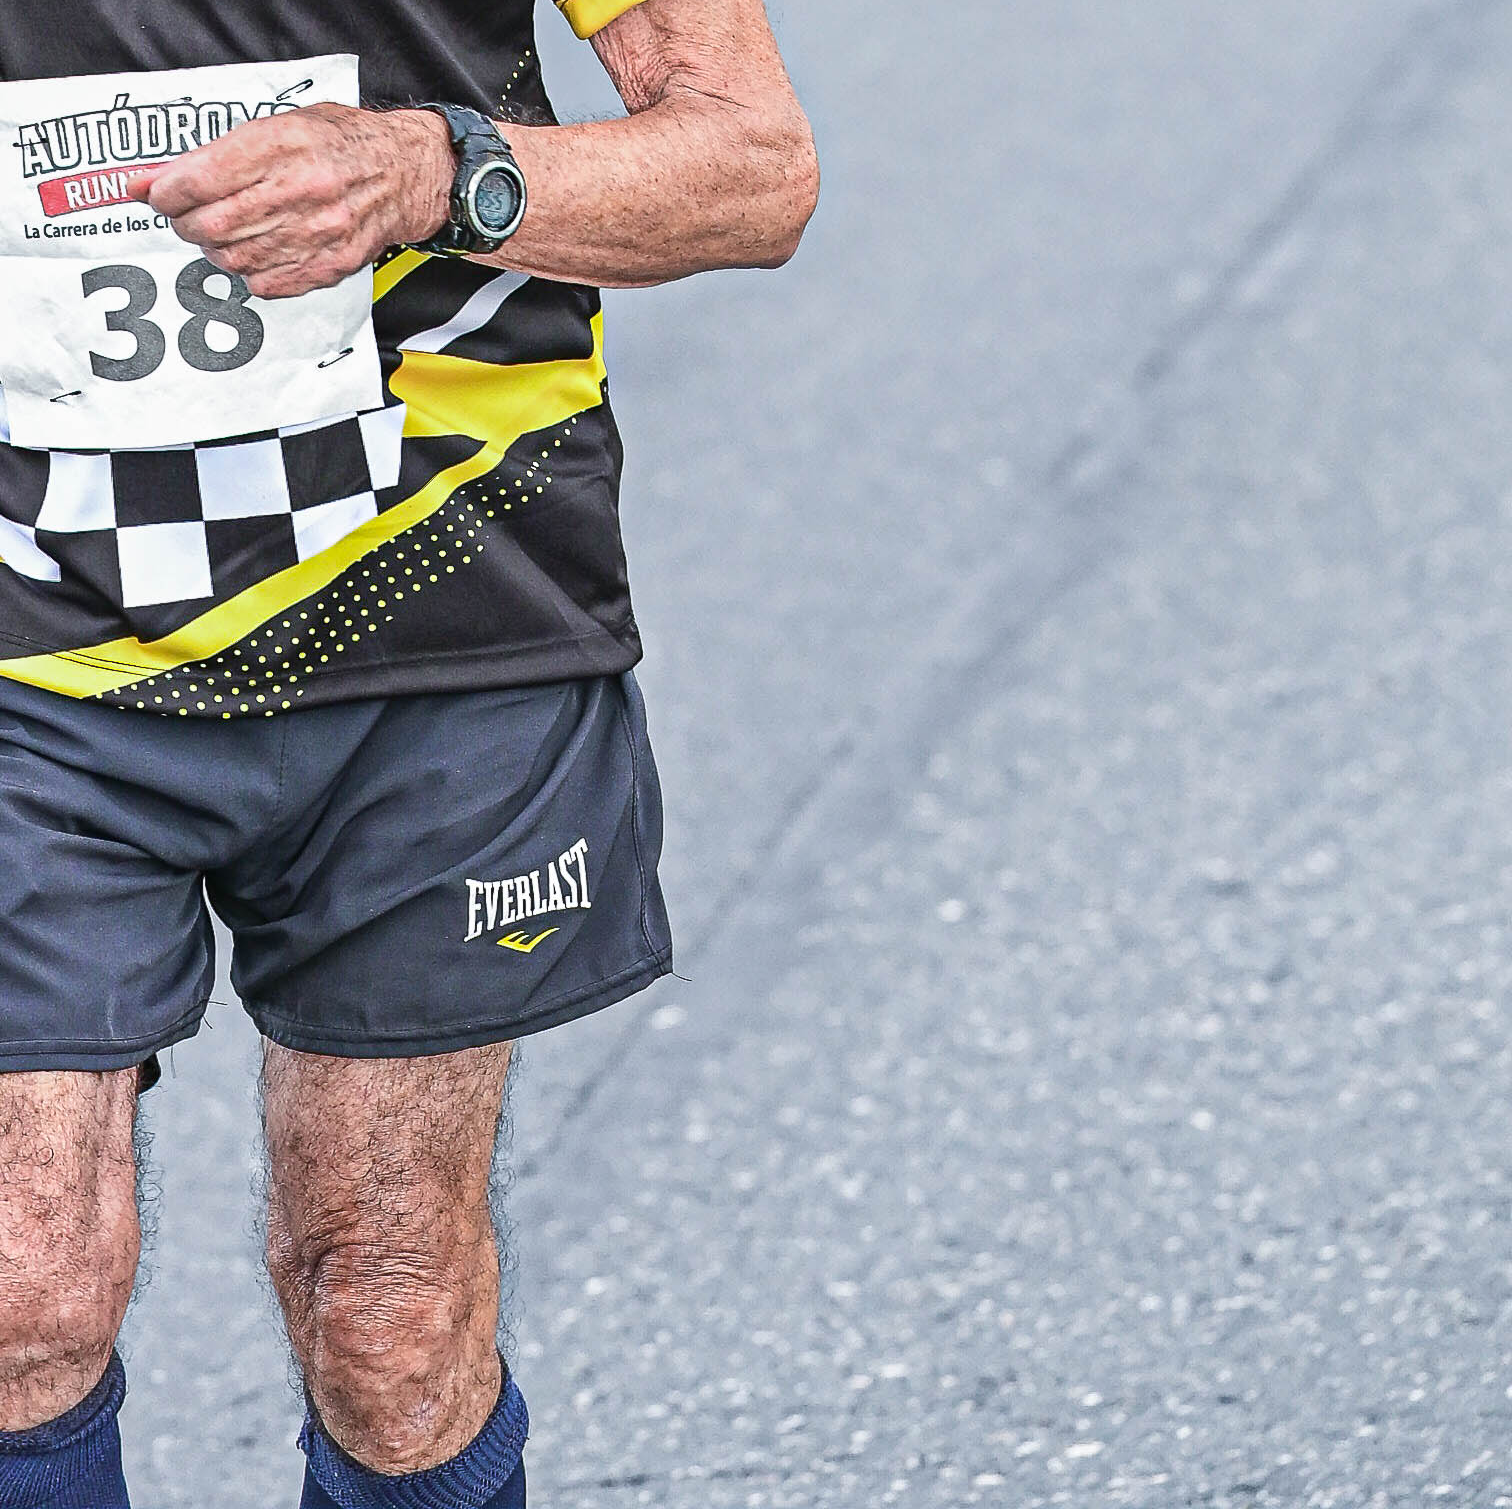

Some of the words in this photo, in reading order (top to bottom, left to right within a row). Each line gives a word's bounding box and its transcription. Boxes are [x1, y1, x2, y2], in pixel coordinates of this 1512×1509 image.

[19, 93, 301, 178] AUTÓDRO
[24, 224, 40, 239] La
[43, 223, 97, 239] Carrera
[102, 218, 122, 234] de
[126, 216, 149, 232] los
[80, 258, 264, 382] 38
[464, 838, 591, 942] EVERLAST
